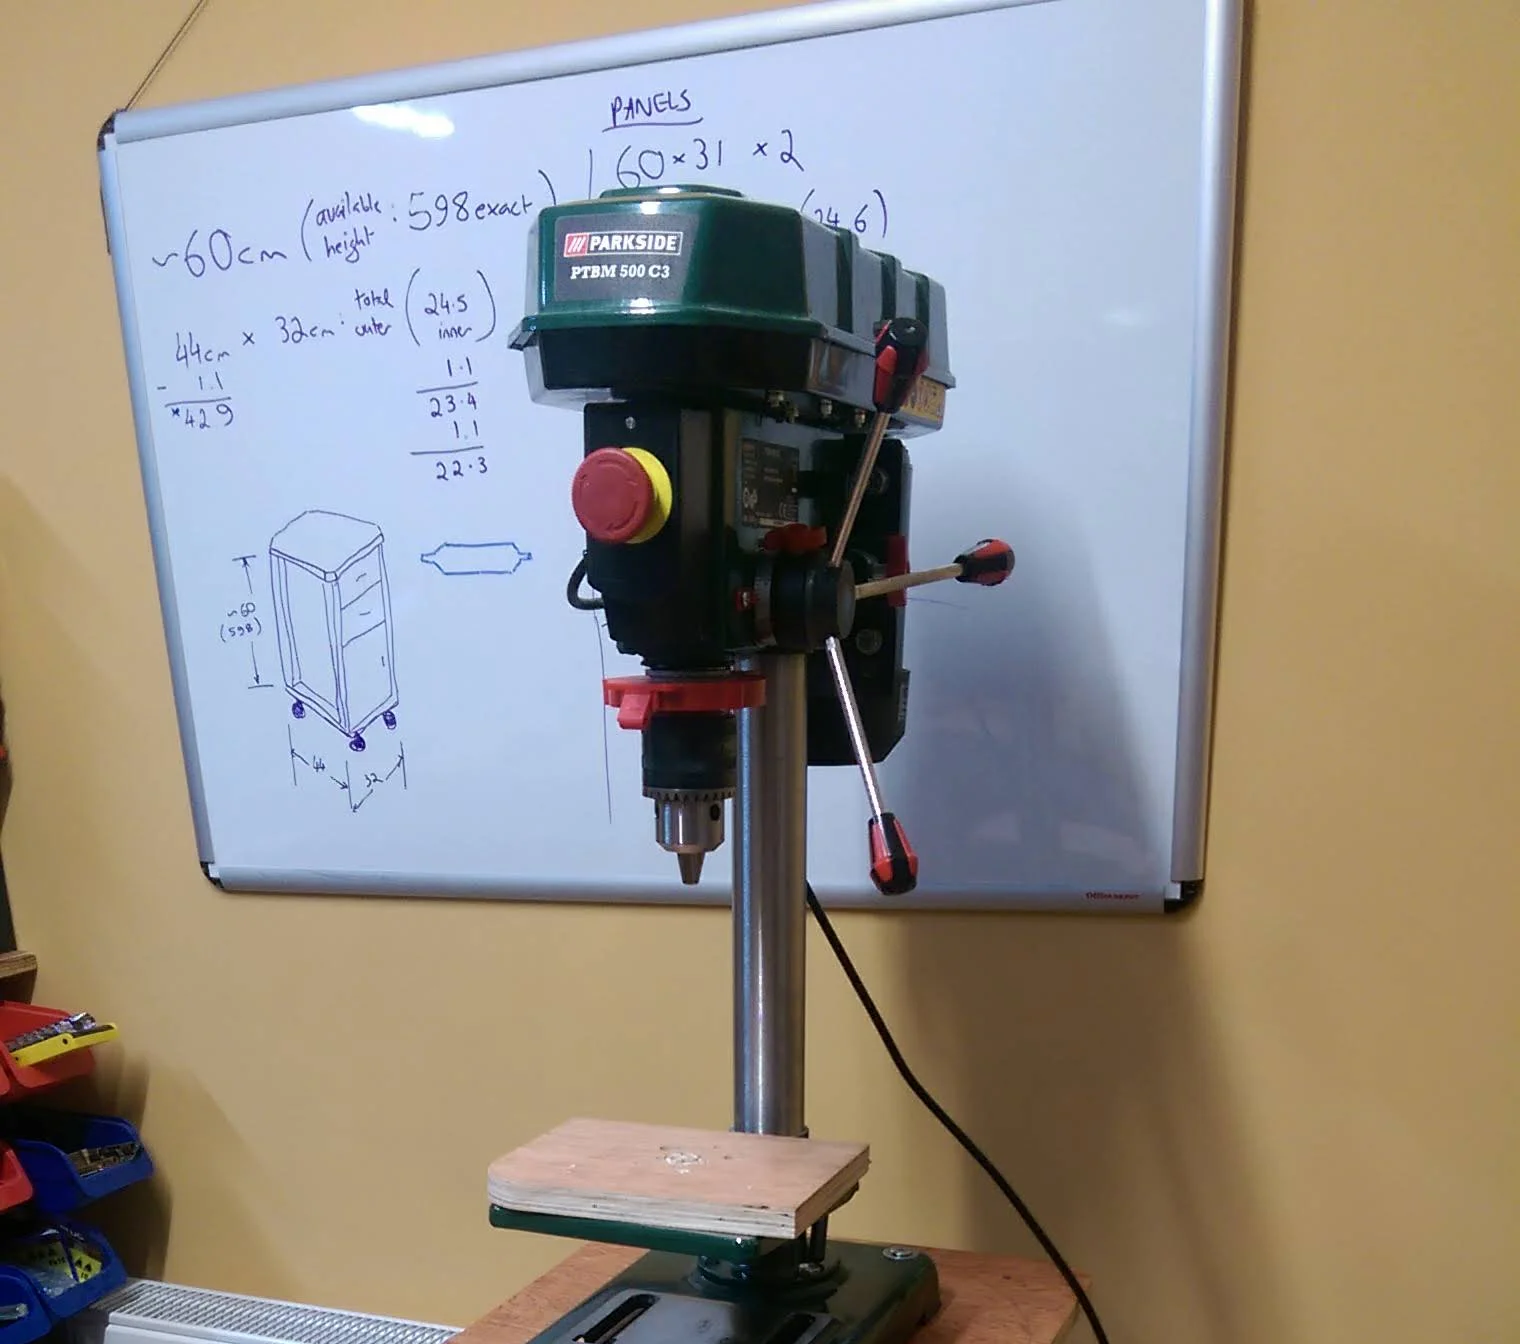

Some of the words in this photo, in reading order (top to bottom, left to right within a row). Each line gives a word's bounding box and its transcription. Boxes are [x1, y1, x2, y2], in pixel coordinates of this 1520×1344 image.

[610, 88, 691, 121] PANELS
[315, 191, 382, 226] available
[324, 226, 375, 263] height
[589, 234, 678, 251] PARKSIDE
[570, 265, 617, 280] PTBM
[620, 264, 645, 278] 500
[648, 265, 670, 279] C3
[438, 322, 472, 341] inner
[175, 331, 231, 368] 44cm
